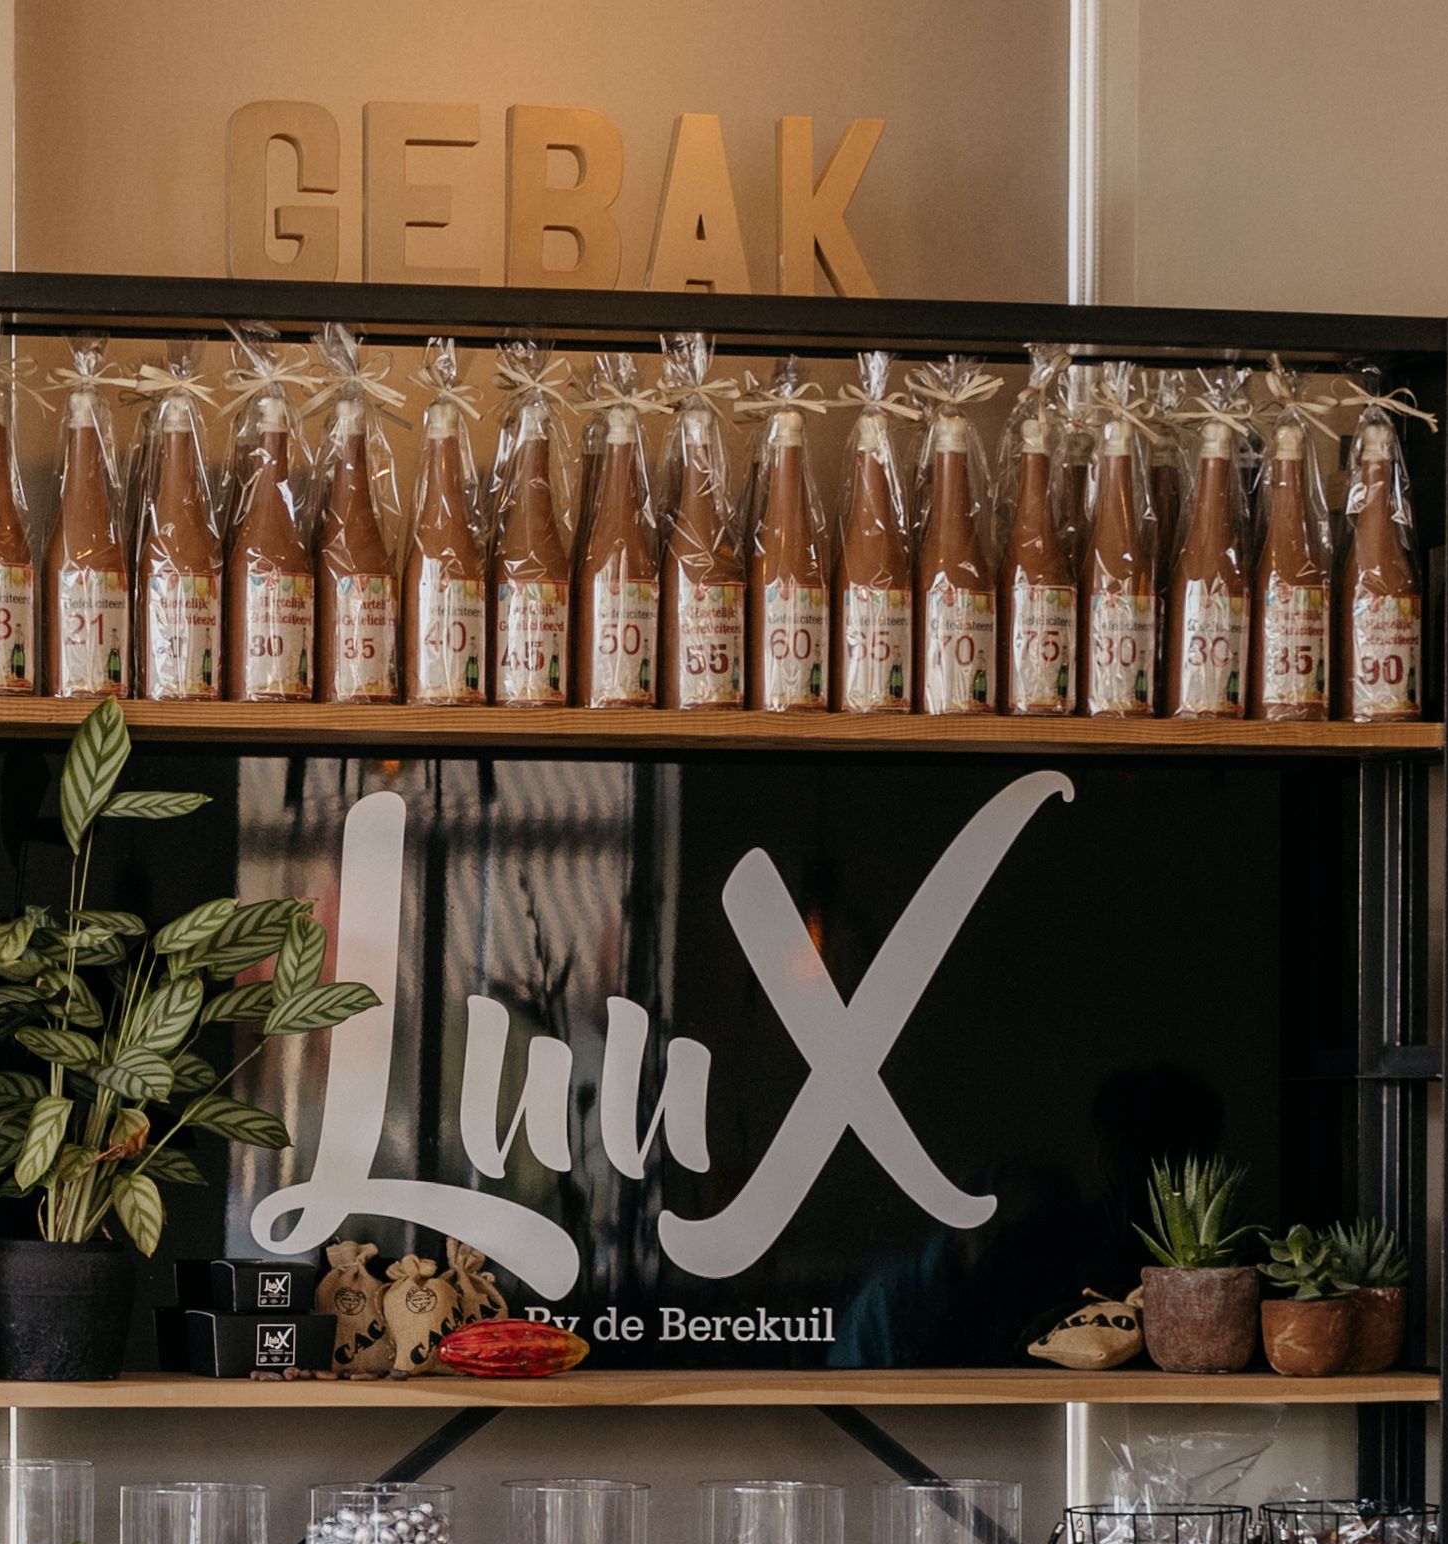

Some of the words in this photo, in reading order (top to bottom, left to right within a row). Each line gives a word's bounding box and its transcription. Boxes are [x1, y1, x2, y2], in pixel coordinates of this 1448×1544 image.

[225, 100, 887, 298] GEBAK
[65, 612, 104, 646] 21
[424, 620, 467, 656] 40
[598, 623, 641, 656] 50
[770, 628, 812, 661] 60
[249, 634, 284, 658] 30
[344, 637, 376, 660] 35
[500, 640, 545, 672] 45
[685, 643, 729, 675] 55
[1023, 630, 1060, 662] 75
[1360, 654, 1404, 686] 90
[249, 769, 1076, 1299] LuuX
[594, 1306, 645, 1342] de
[658, 1306, 837, 1343] Berekuil
